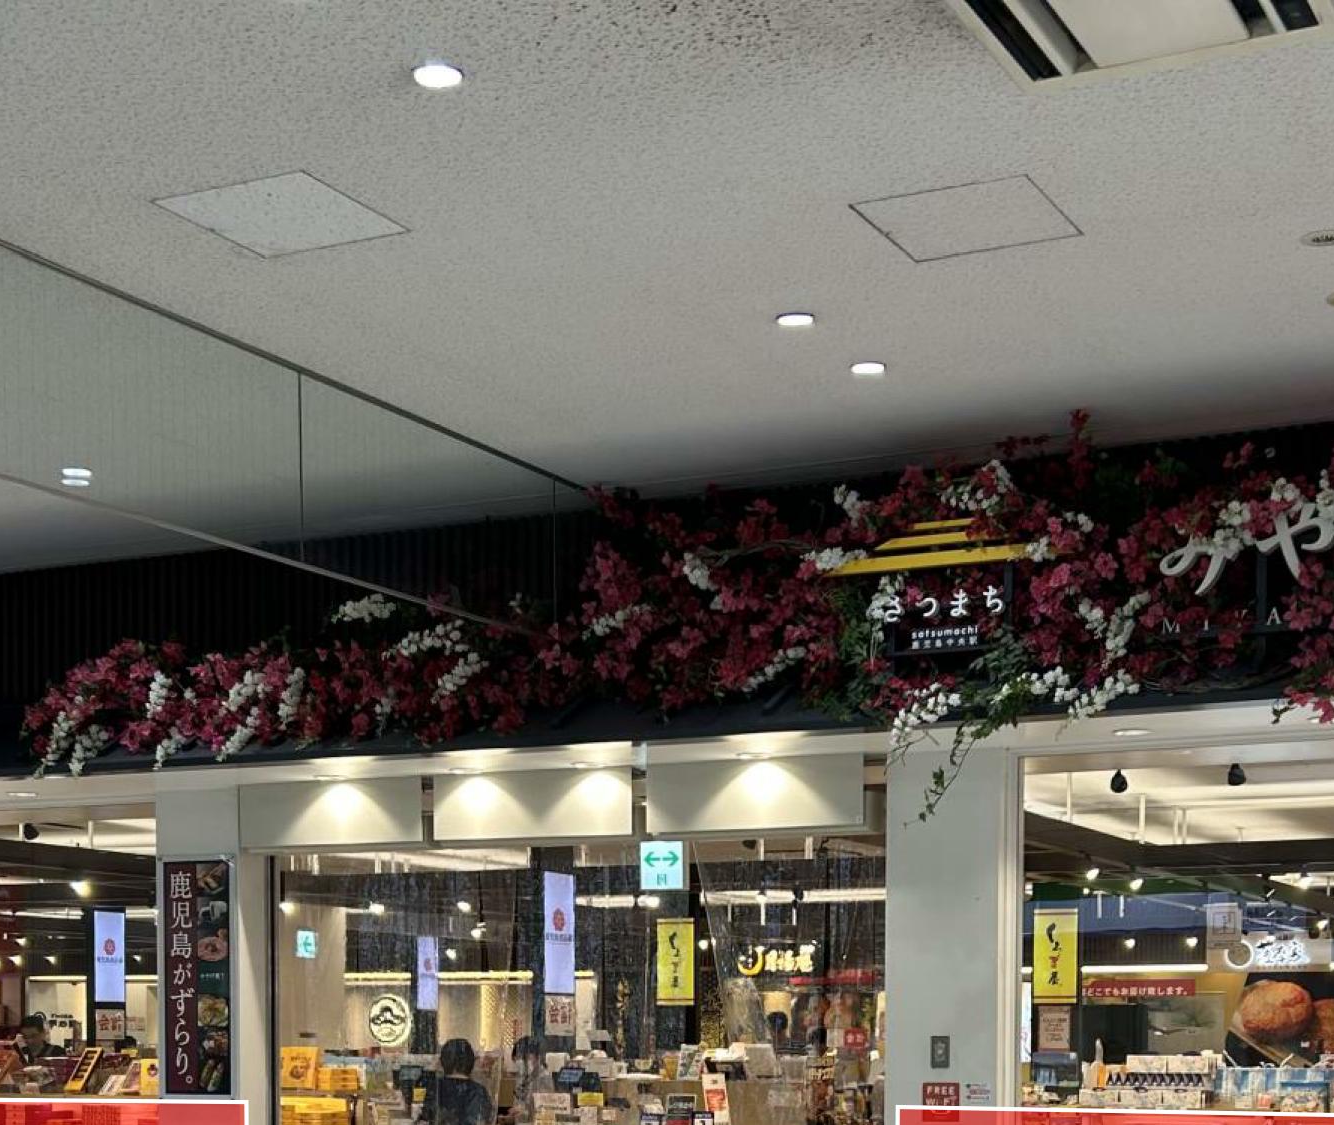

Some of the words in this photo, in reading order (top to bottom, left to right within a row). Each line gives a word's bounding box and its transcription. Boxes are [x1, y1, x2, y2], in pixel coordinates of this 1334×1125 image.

[884, 585, 1004, 623] さつまち
[911, 625, 978, 639] satsumachi
[170, 871, 195, 1084] 鹿児島がずらり。
[927, 1085, 955, 1096] FREE
